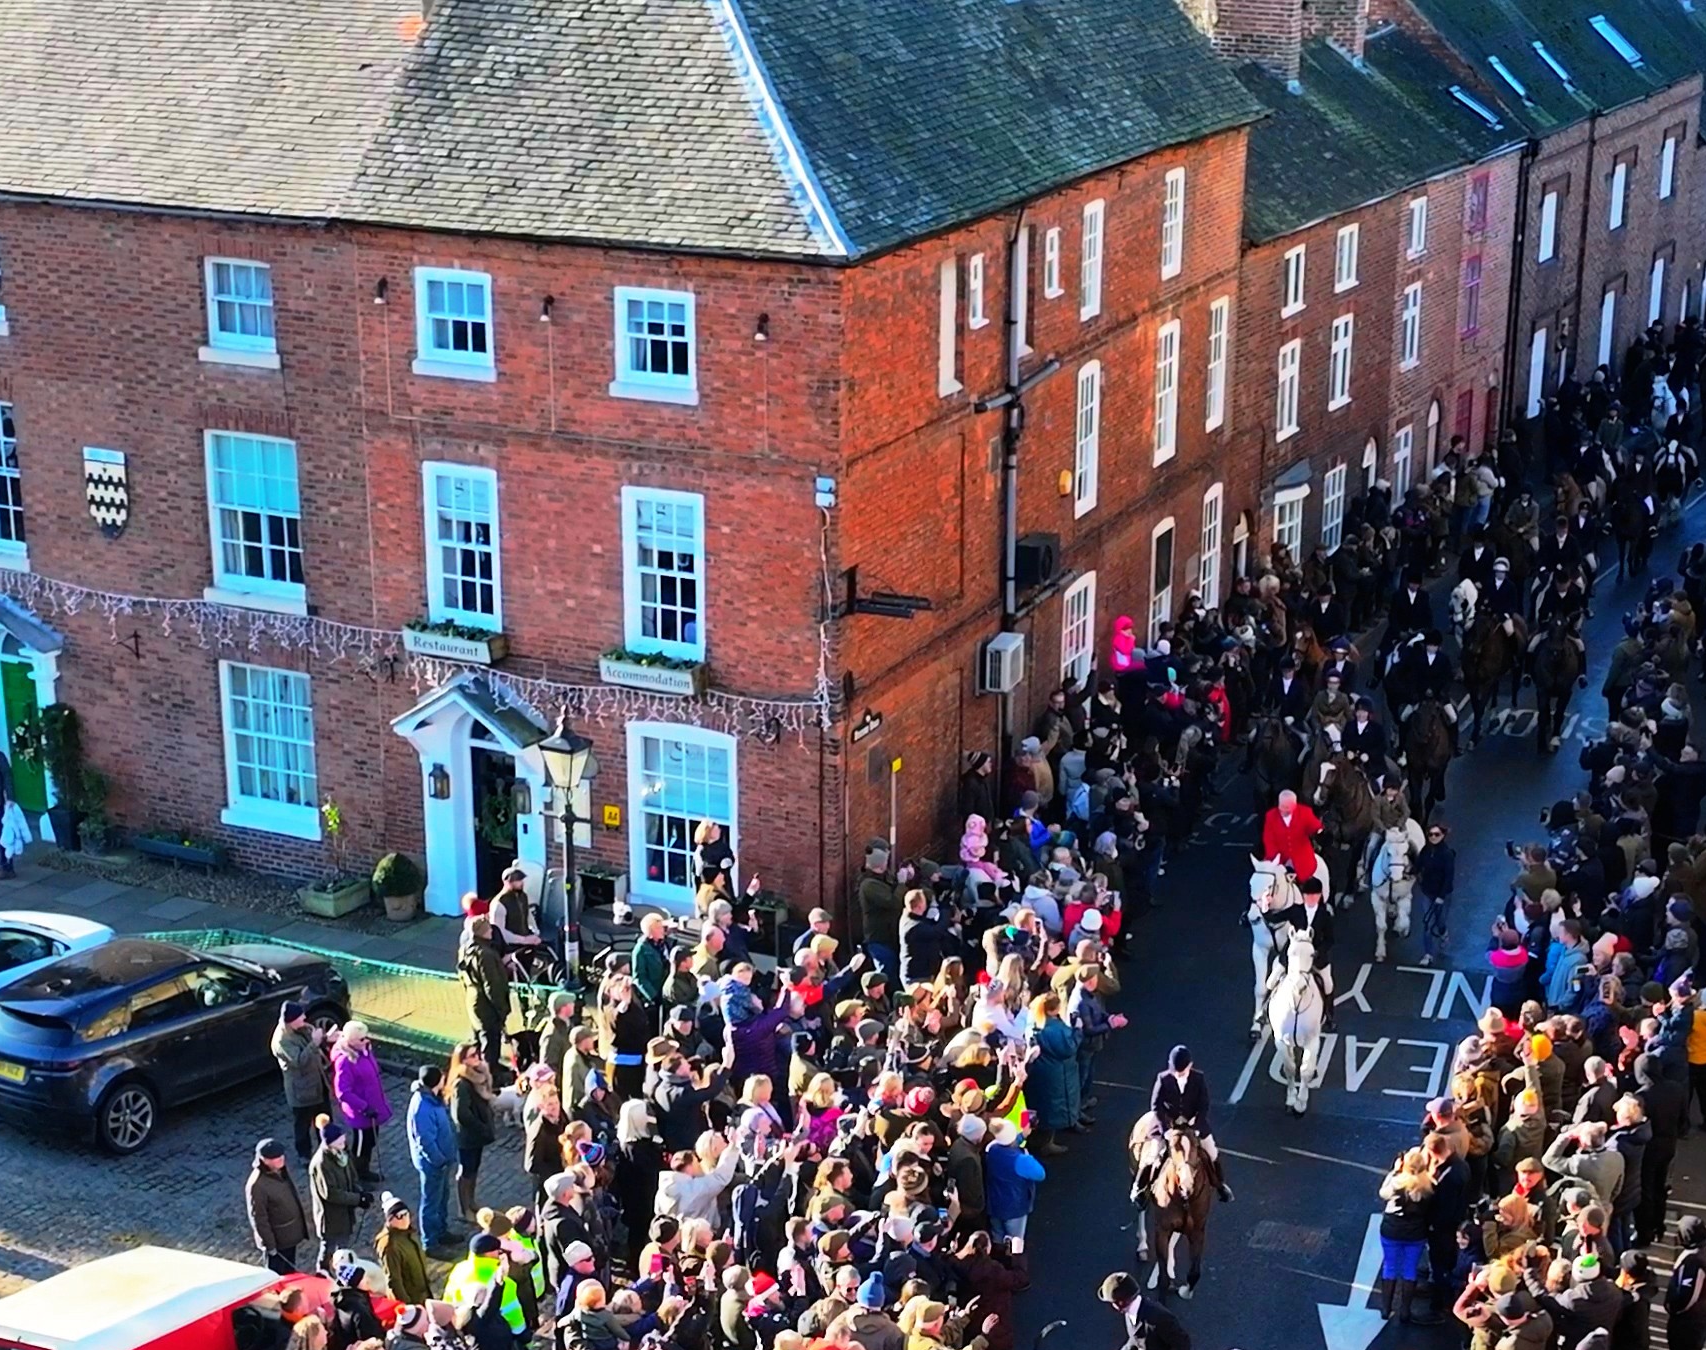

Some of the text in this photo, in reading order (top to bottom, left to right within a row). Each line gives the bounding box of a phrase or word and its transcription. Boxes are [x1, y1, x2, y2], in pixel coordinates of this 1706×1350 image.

[412, 635, 479, 657] Restaurant
[603, 664, 691, 689] Accommodation
[1333, 963, 1493, 1020] NLY
